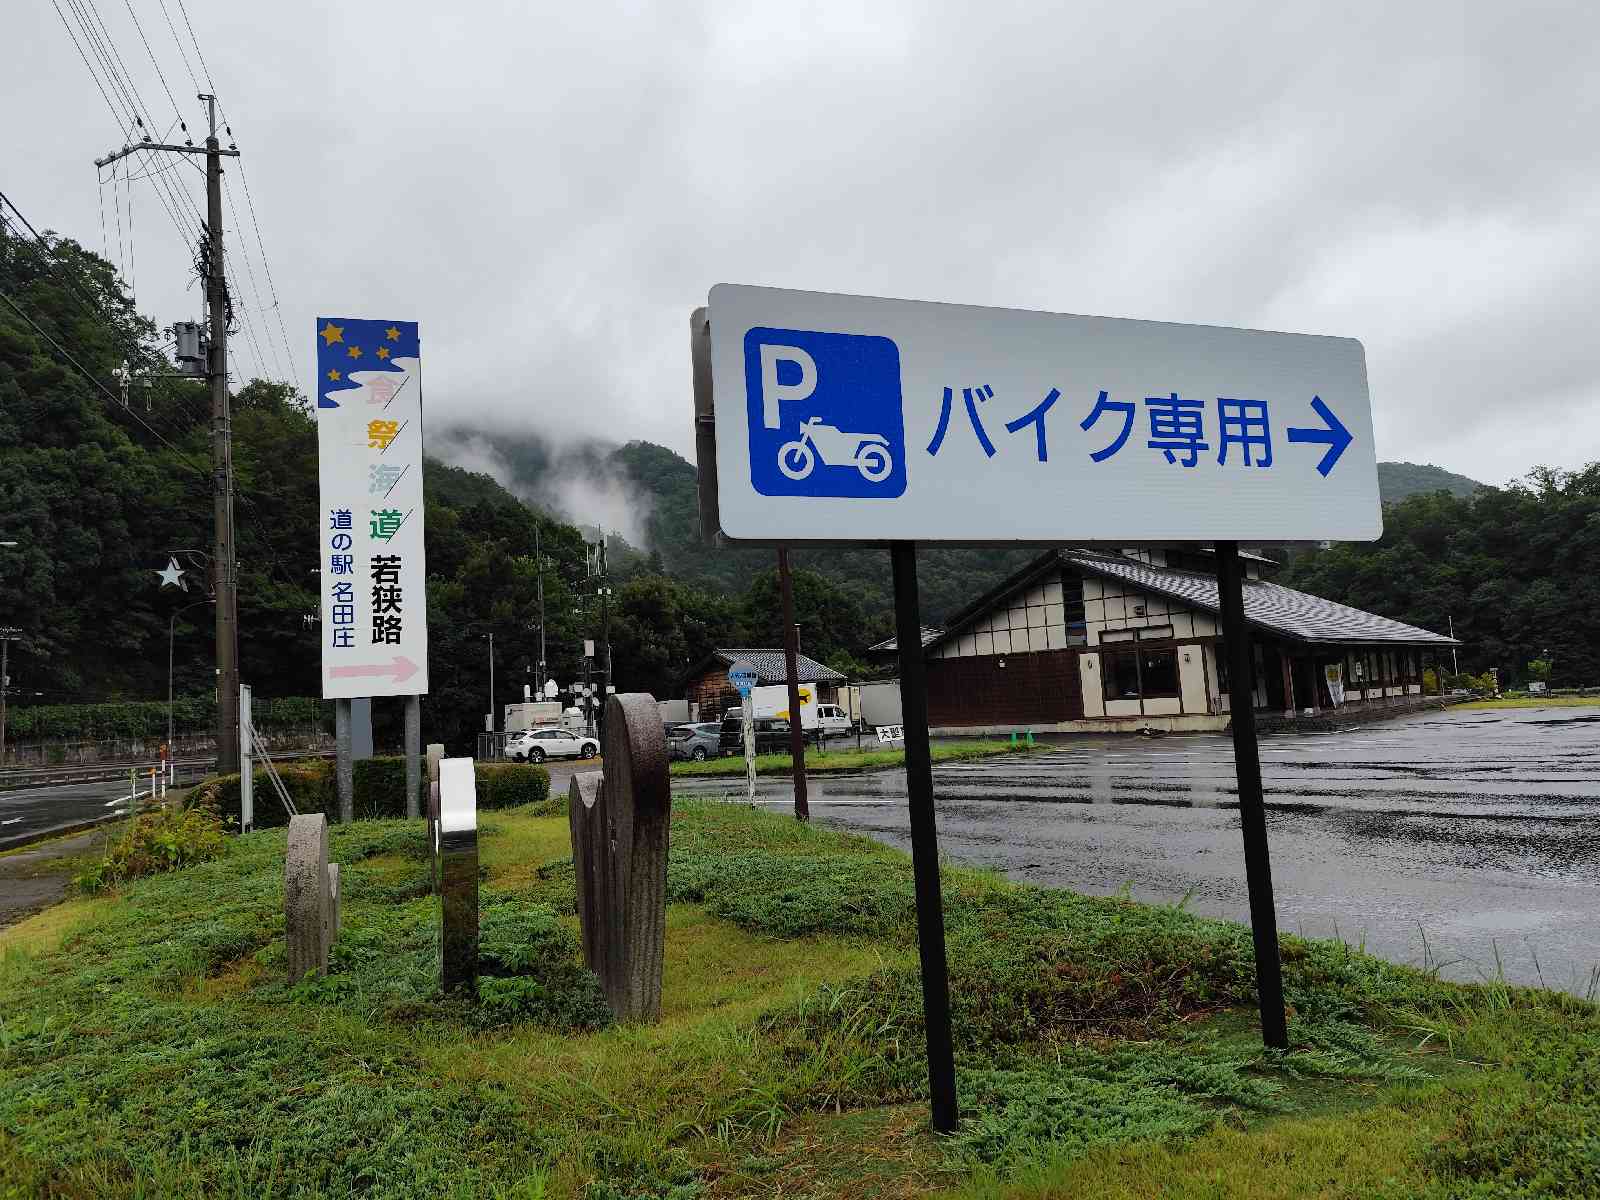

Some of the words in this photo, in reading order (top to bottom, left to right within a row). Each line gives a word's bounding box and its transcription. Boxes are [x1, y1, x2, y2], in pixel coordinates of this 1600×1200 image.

[759, 343, 818, 429] P
[926, 383, 1273, 468] バイク専用
